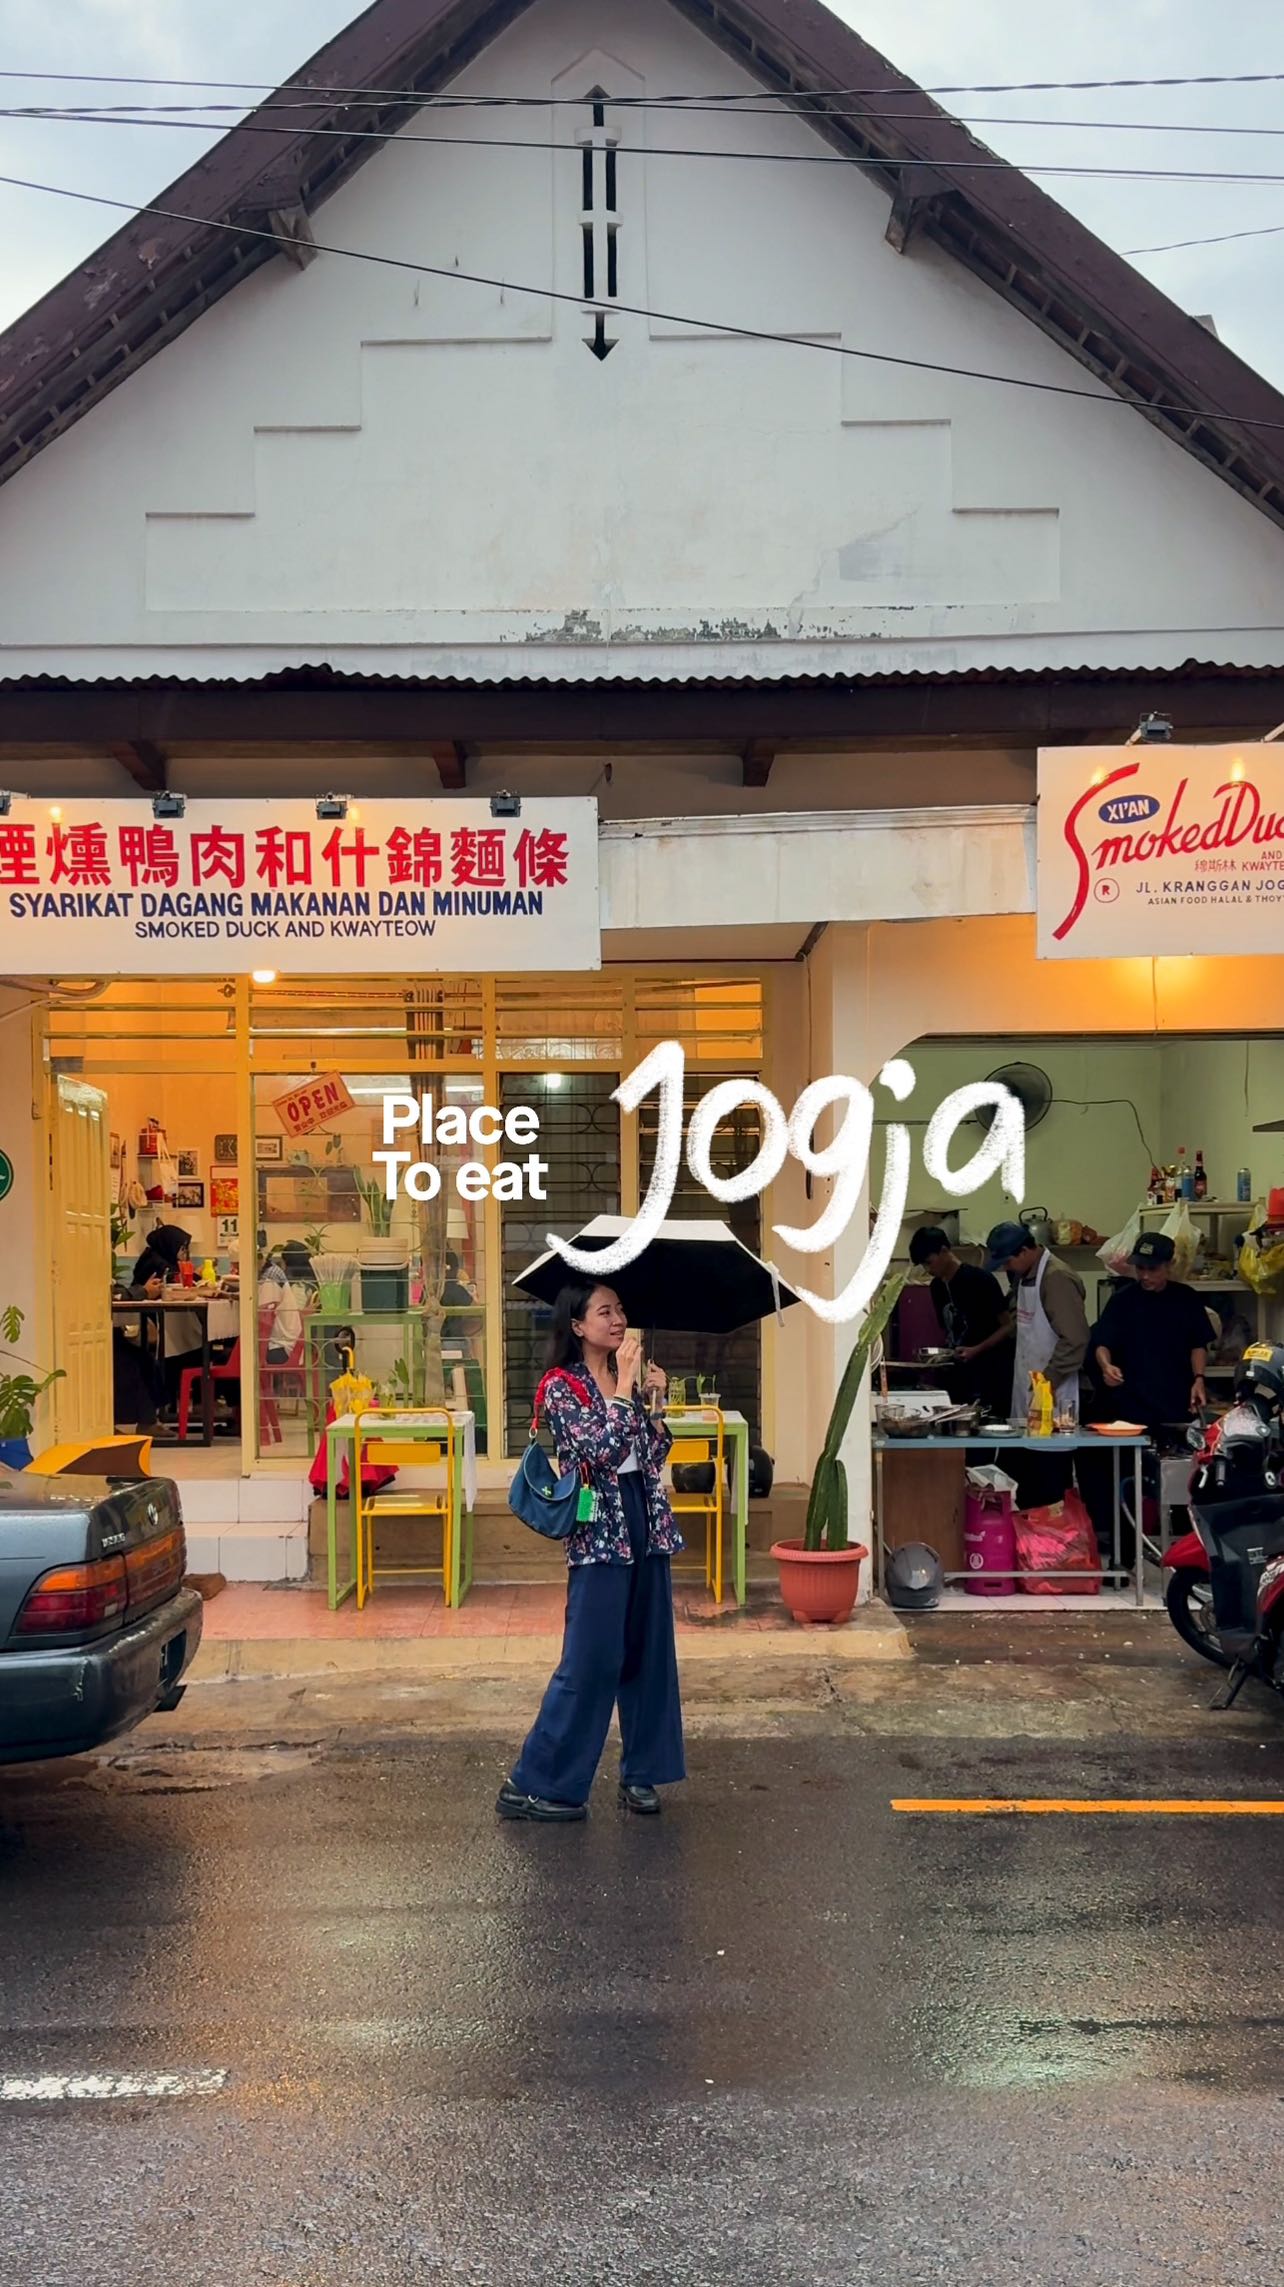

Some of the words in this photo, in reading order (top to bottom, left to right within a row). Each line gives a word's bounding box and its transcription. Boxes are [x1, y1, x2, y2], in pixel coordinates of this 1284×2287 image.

[1052, 762, 1232, 941] Smoked
[1261, 850, 1282, 860] AND
[1136, 881, 1157, 894] JL.
[1163, 880, 1251, 893] KRANGGAN
[10, 892, 134, 918] SYARIKAT
[141, 892, 243, 917] DAGANG
[251, 891, 370, 917] MAKANAN
[378, 891, 426, 916] DAN
[433, 890, 543, 916] MINUMAN
[1148, 897, 1177, 905] ASIAN
[1180, 896, 1208, 905] FOOD
[1210, 895, 1243, 904] HALAL
[135, 921, 220, 939] SMOKED
[226, 920, 281, 938] DUCK
[284, 920, 325, 938] AND
[330, 919, 436, 937] KWAYTEOW
[287, 1082, 340, 1122] OPEN
[221, 1218, 238, 1233] 11
